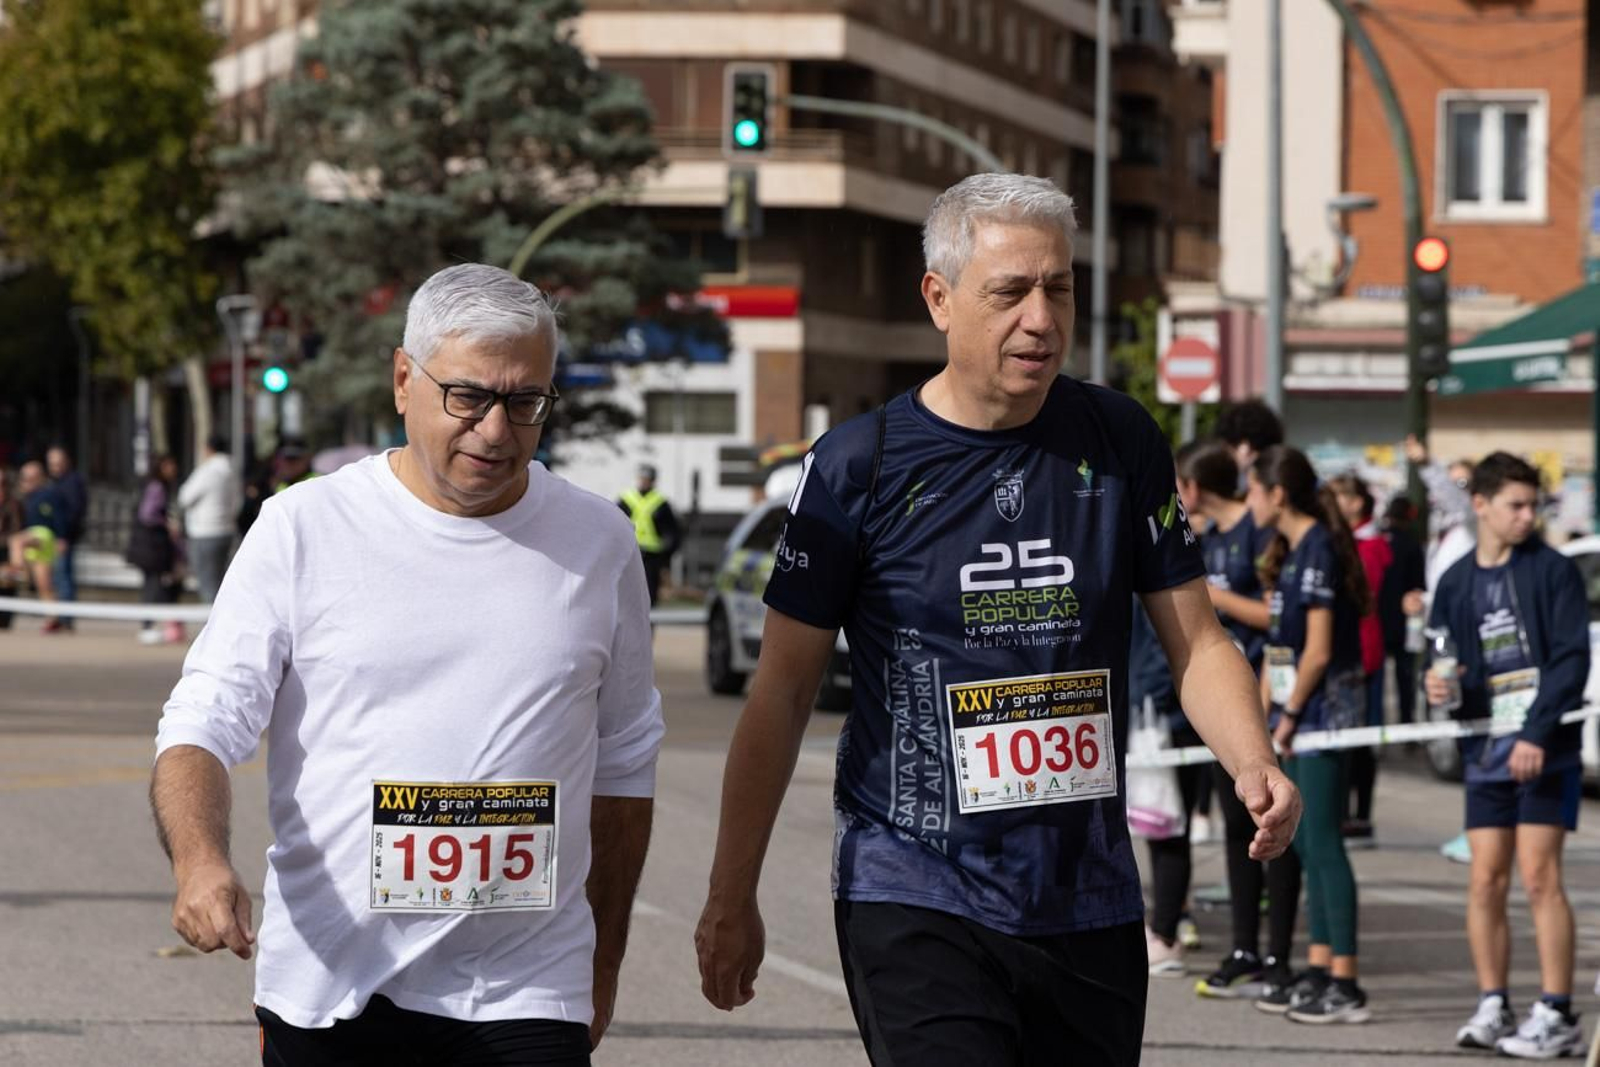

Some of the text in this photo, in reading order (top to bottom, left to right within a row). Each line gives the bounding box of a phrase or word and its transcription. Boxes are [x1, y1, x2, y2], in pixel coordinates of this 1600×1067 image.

[960, 539, 1075, 592] 25
[961, 586, 1076, 608] CARRERA
[964, 602, 1080, 624] POPULAR
[965, 618, 1081, 637] y gran caminata
[892, 627, 922, 651] IES
[995, 677, 1103, 697] CARRERA POPULAR
[956, 687, 993, 713] XXV
[996, 688, 1104, 709] y gran caminata
[975, 712, 994, 724] POR
[996, 711, 1009, 722] LA
[1010, 709, 1028, 720] PAZ
[1037, 707, 1050, 718] LA
[975, 722, 1100, 779] 1036
[379, 786, 419, 810] XXV
[421, 787, 549, 799] CARRERA POPULAR
[421, 797, 549, 811] y gran caminata
[895, 761, 917, 828] SANTA
[396, 812, 417, 824] POR
[417, 814, 433, 824] LA
[433, 813, 453, 824] PAZ
[462, 813, 477, 824] LA
[922, 800, 942, 830] DE
[393, 833, 534, 883] 1915
